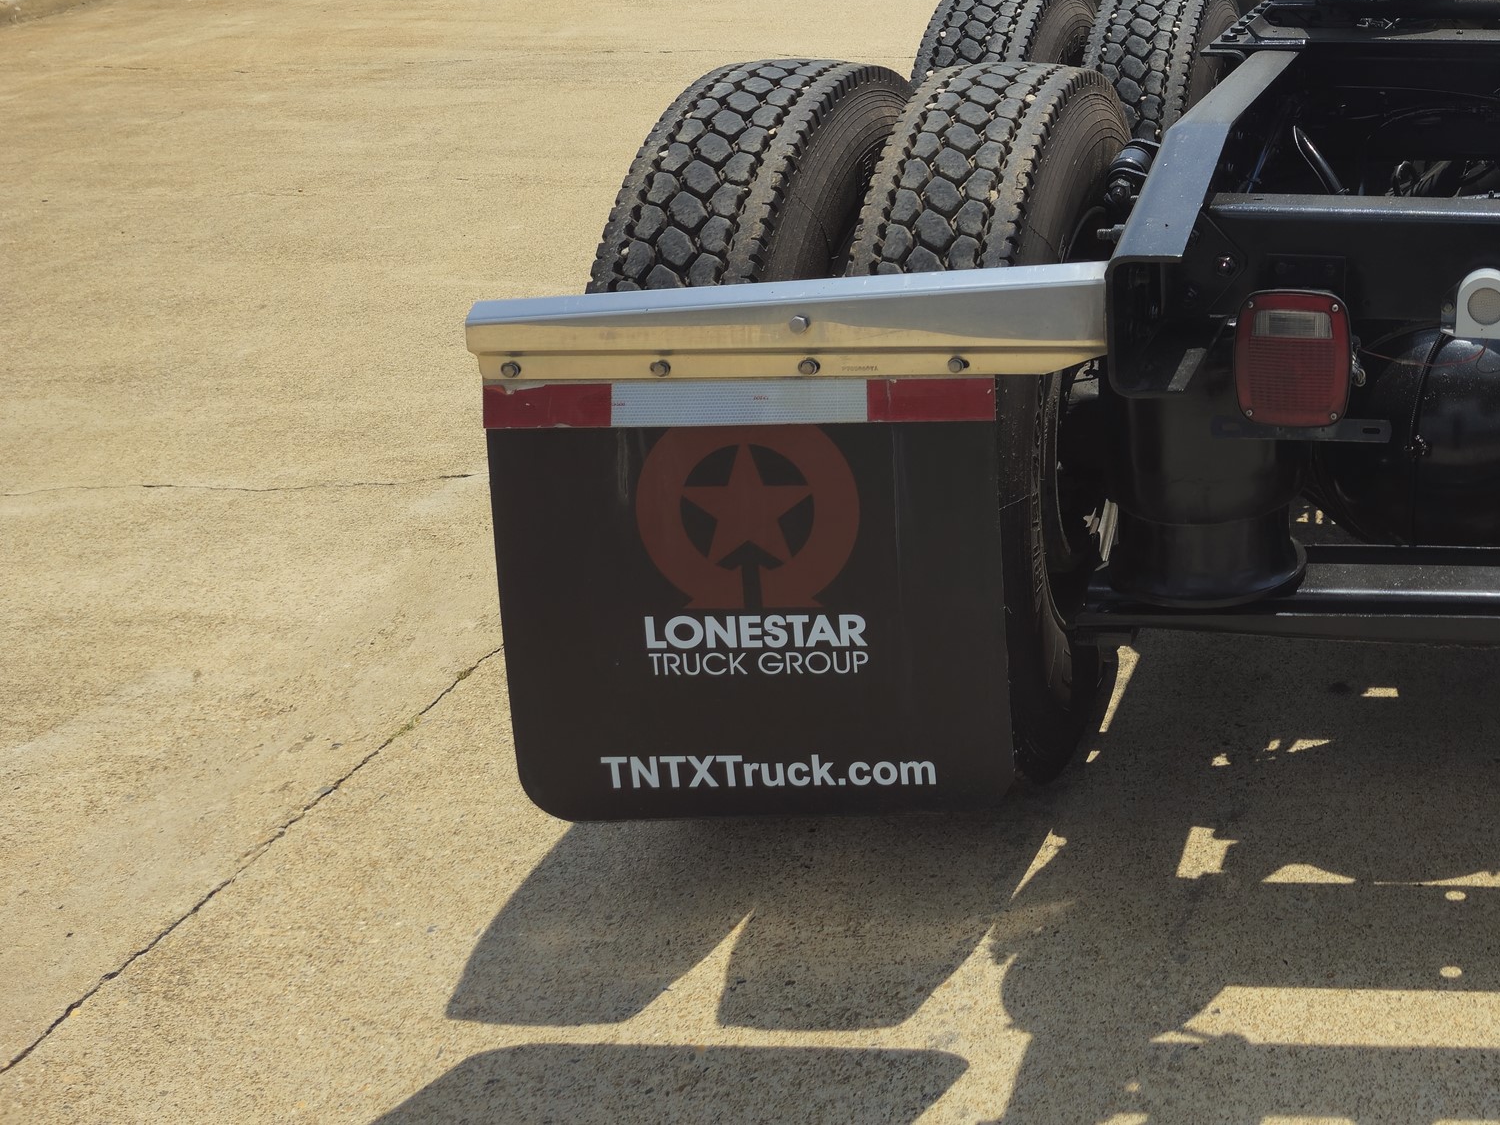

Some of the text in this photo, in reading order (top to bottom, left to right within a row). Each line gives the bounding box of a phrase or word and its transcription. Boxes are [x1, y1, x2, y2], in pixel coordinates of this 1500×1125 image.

[645, 614, 868, 649] LONESTAR
[648, 650, 869, 676] TRUCK GROUP
[600, 754, 937, 789] TNTXTruck.com
